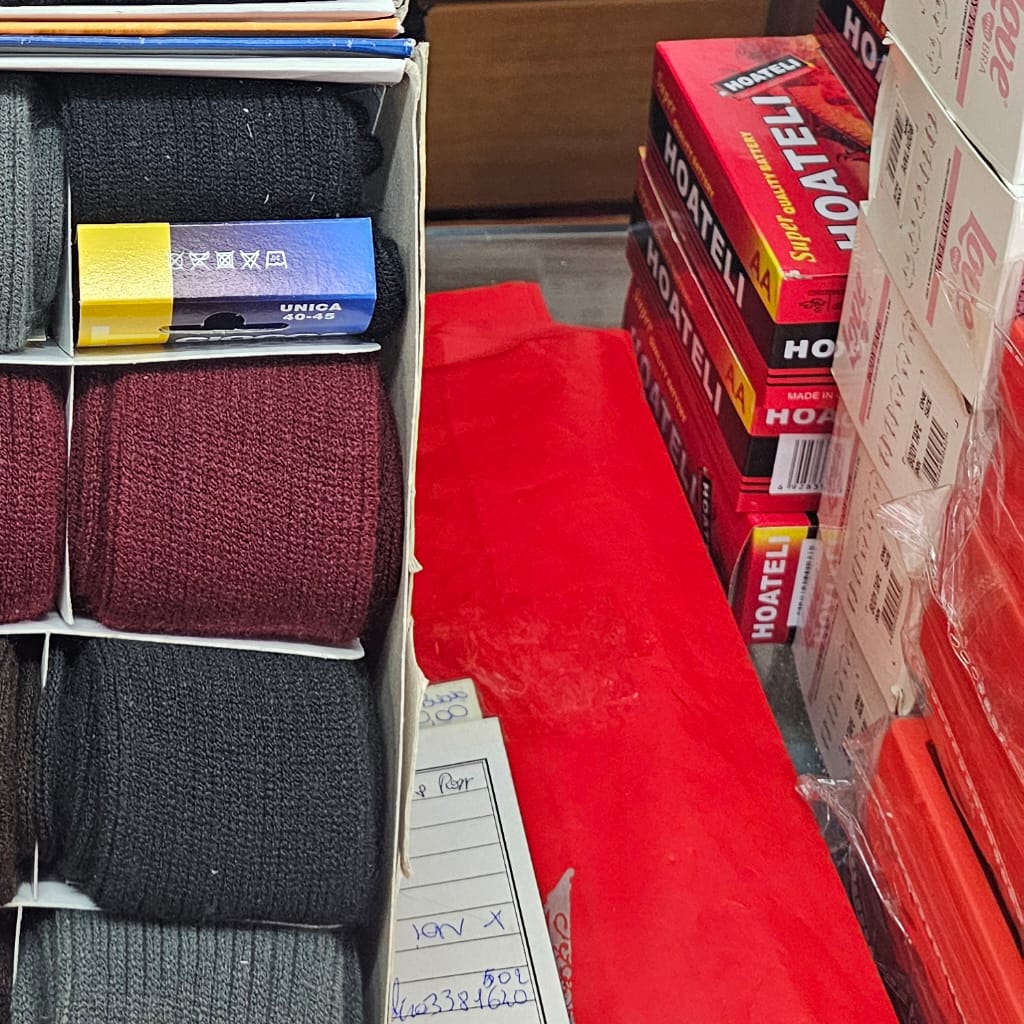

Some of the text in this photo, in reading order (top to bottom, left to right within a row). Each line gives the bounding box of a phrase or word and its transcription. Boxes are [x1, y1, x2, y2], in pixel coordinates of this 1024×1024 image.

[963, 13, 976, 50] TAPE
[723, 57, 802, 93] HOATELI
[977, 42, 990, 74] BRA
[739, 130, 771, 179] BATTERY
[751, 94, 860, 252] HOATELI
[764, 177, 797, 215] QUALITY
[663, 132, 746, 310] HOATELI
[776, 213, 816, 264] Super
[748, 249, 773, 303] AA
[279, 302, 342, 313] UNICA
[282, 313, 336, 322] 40-45
[646, 238, 721, 416] HOATELI
[725, 361, 747, 413] AA
[787, 391, 834, 401] MADE IN
[751, 534, 791, 642] HOATELI
